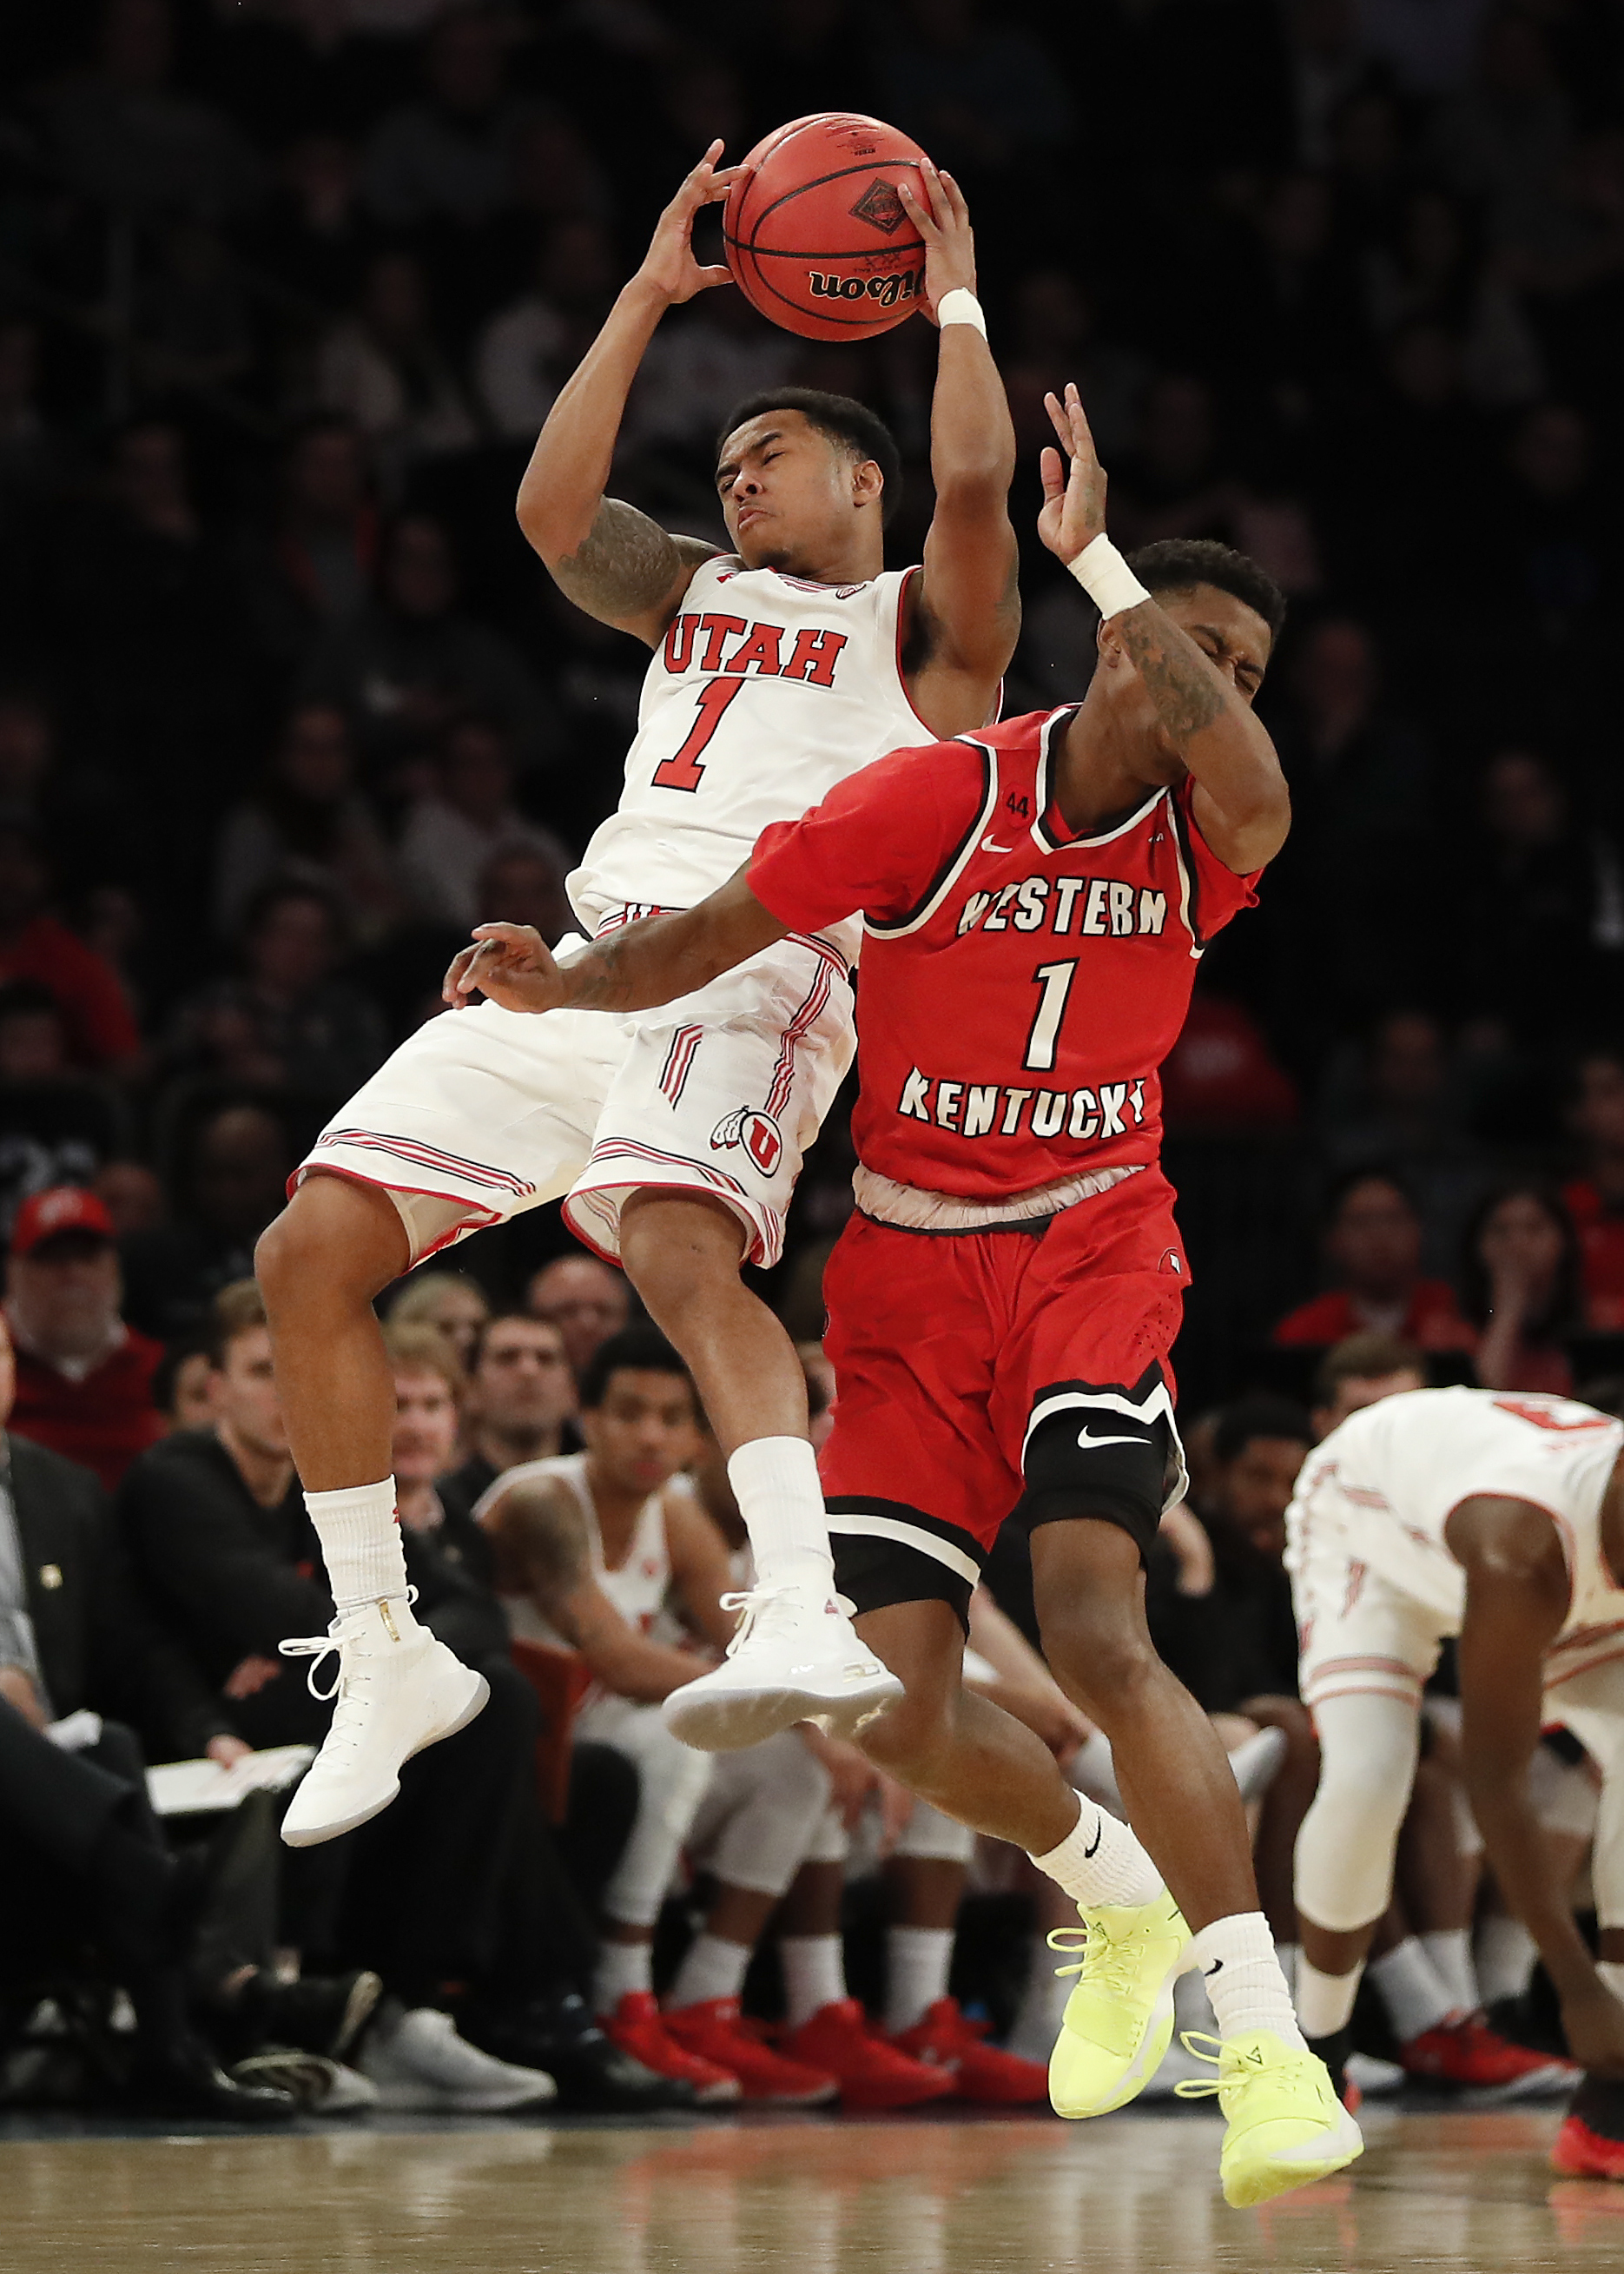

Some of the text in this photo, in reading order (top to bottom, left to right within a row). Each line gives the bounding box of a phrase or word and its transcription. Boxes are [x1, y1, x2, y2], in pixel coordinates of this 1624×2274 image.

[663, 613, 848, 688] UTAH
[650, 677, 749, 793] 1
[1007, 791, 1028, 818] 44
[957, 876, 1168, 937] WESTERN
[1021, 957, 1080, 1073] 1
